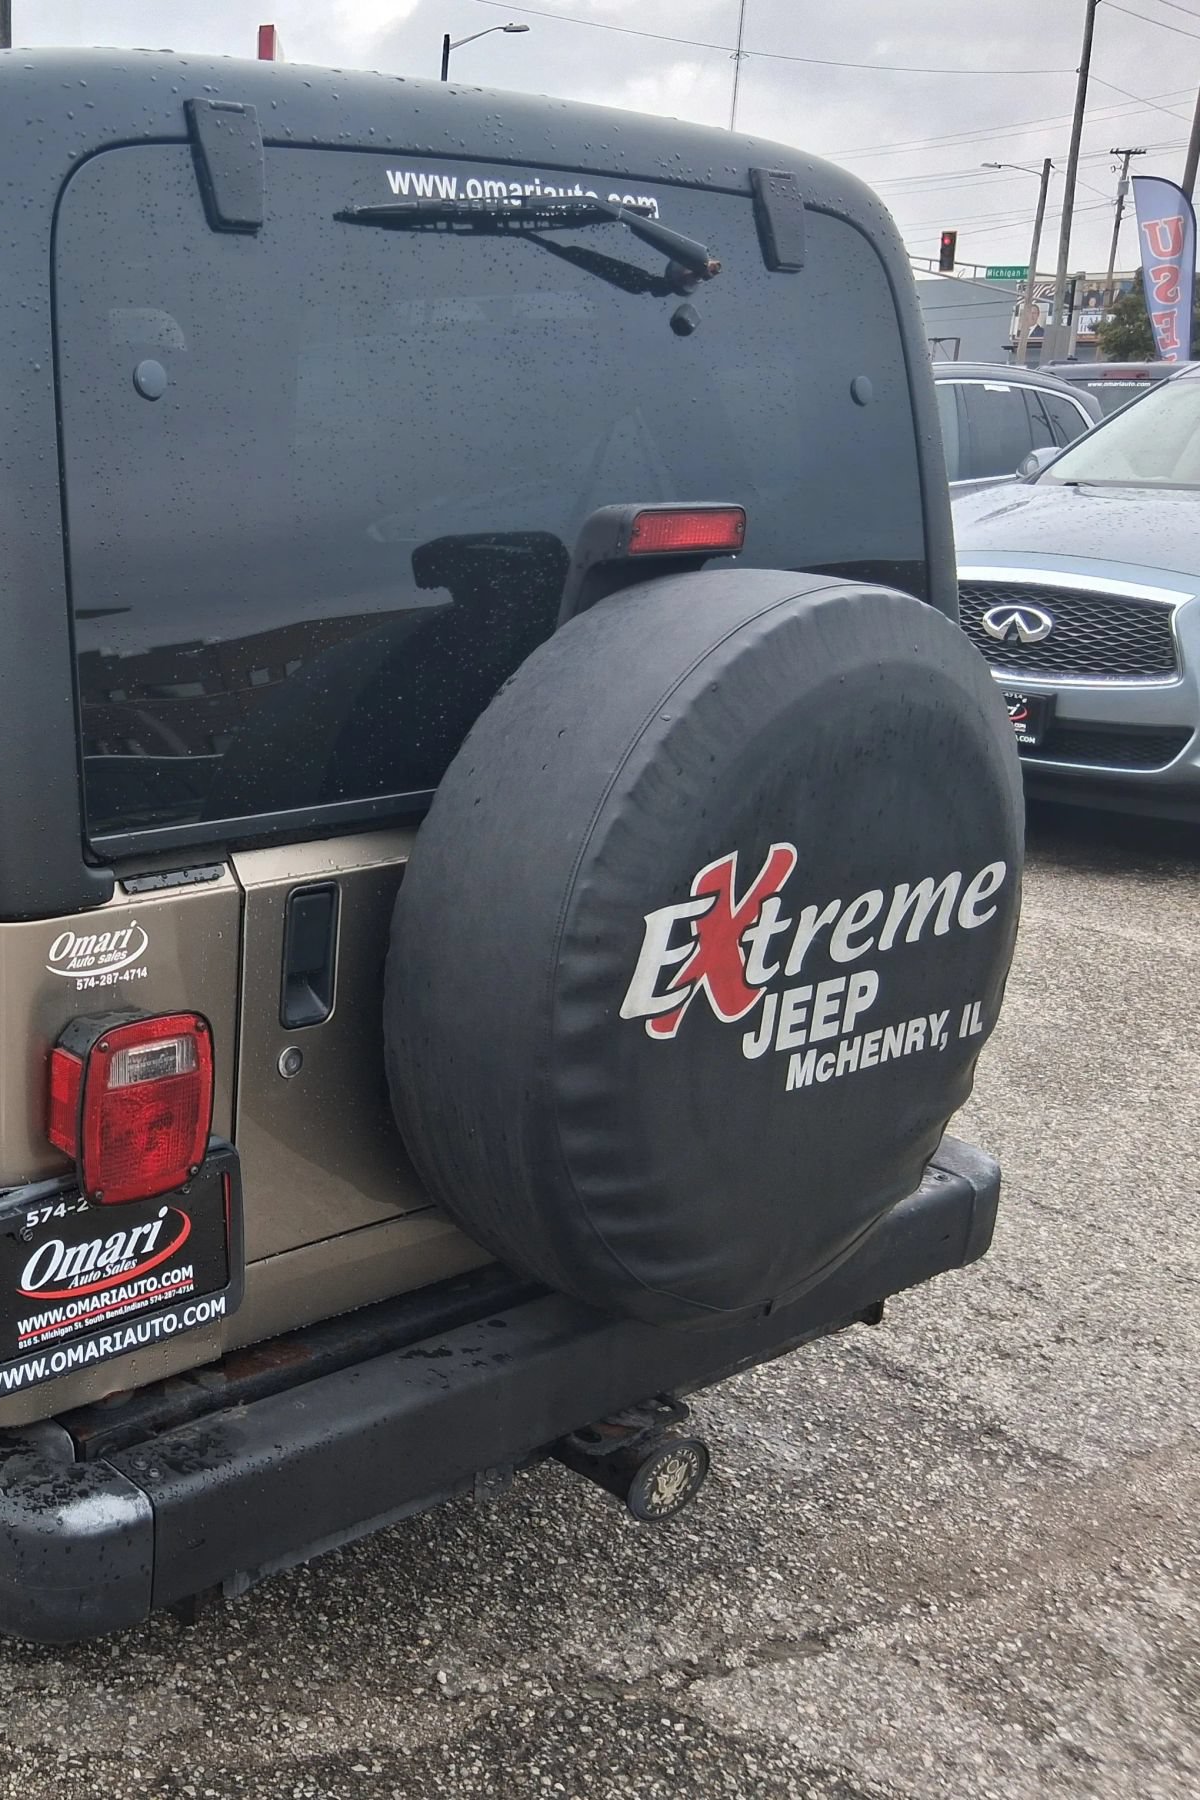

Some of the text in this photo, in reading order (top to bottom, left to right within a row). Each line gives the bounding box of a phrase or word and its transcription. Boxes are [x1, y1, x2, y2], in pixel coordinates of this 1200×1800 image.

[386, 170, 660, 219] www.omariautm
[987, 269, 1020, 278] Michigan
[49, 919, 138, 962] Omari
[66, 956, 96, 970] Auto
[76, 966, 148, 991] 574-287-4714
[742, 969, 879, 1060] JEEP
[784, 1000, 984, 1092] McHENRY, IL
[26, 1197, 90, 1228] 574-2
[21, 1205, 169, 1292] Omari
[68, 1258, 138, 1289] Auto Sales
[17, 1264, 194, 1336] WWW.OMARIAUTO.COM
[18, 1339, 32, 1350] 816
[41, 1325, 73, 1342] Michigan
[84, 1315, 105, 1327] South
[149, 1283, 194, 1306] 574-287-4714
